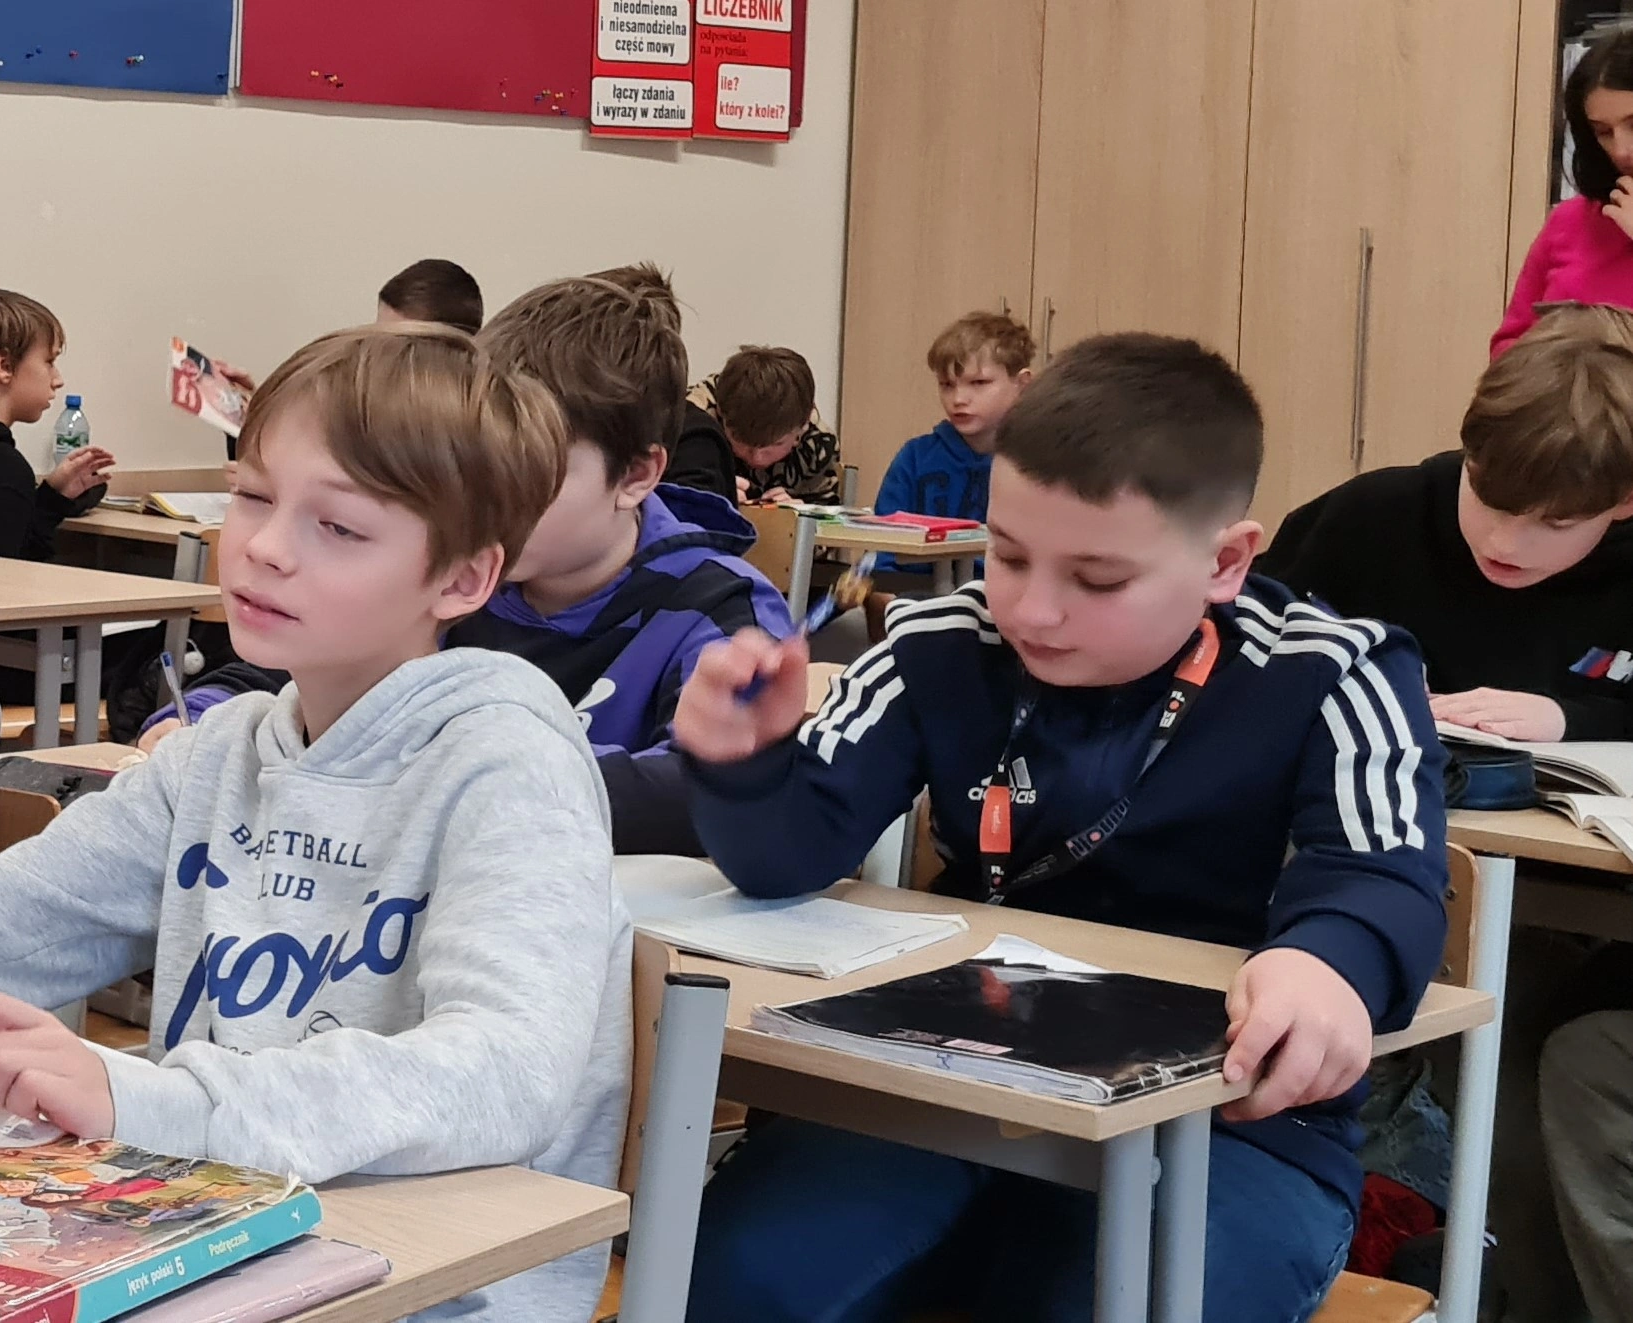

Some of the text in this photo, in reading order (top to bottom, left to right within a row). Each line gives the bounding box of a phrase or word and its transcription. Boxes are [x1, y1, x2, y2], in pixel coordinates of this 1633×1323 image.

[613, 0, 678, 16] nieodmienna
[704, 0, 783, 22] LICZEBNIK
[609, 17, 687, 36] niesamodzielna
[615, 36, 675, 57] część mowy
[612, 84, 675, 103] łączy zdania
[721, 77, 739, 91] ile?
[603, 105, 637, 120] wyrazy
[640, 108, 648, 118] w
[653, 105, 686, 119] zdaniu
[719, 101, 743, 119] który
[747, 108, 752, 117] z
[230, 823, 367, 868] BAETBALL
[257, 872, 316, 902] LUB
